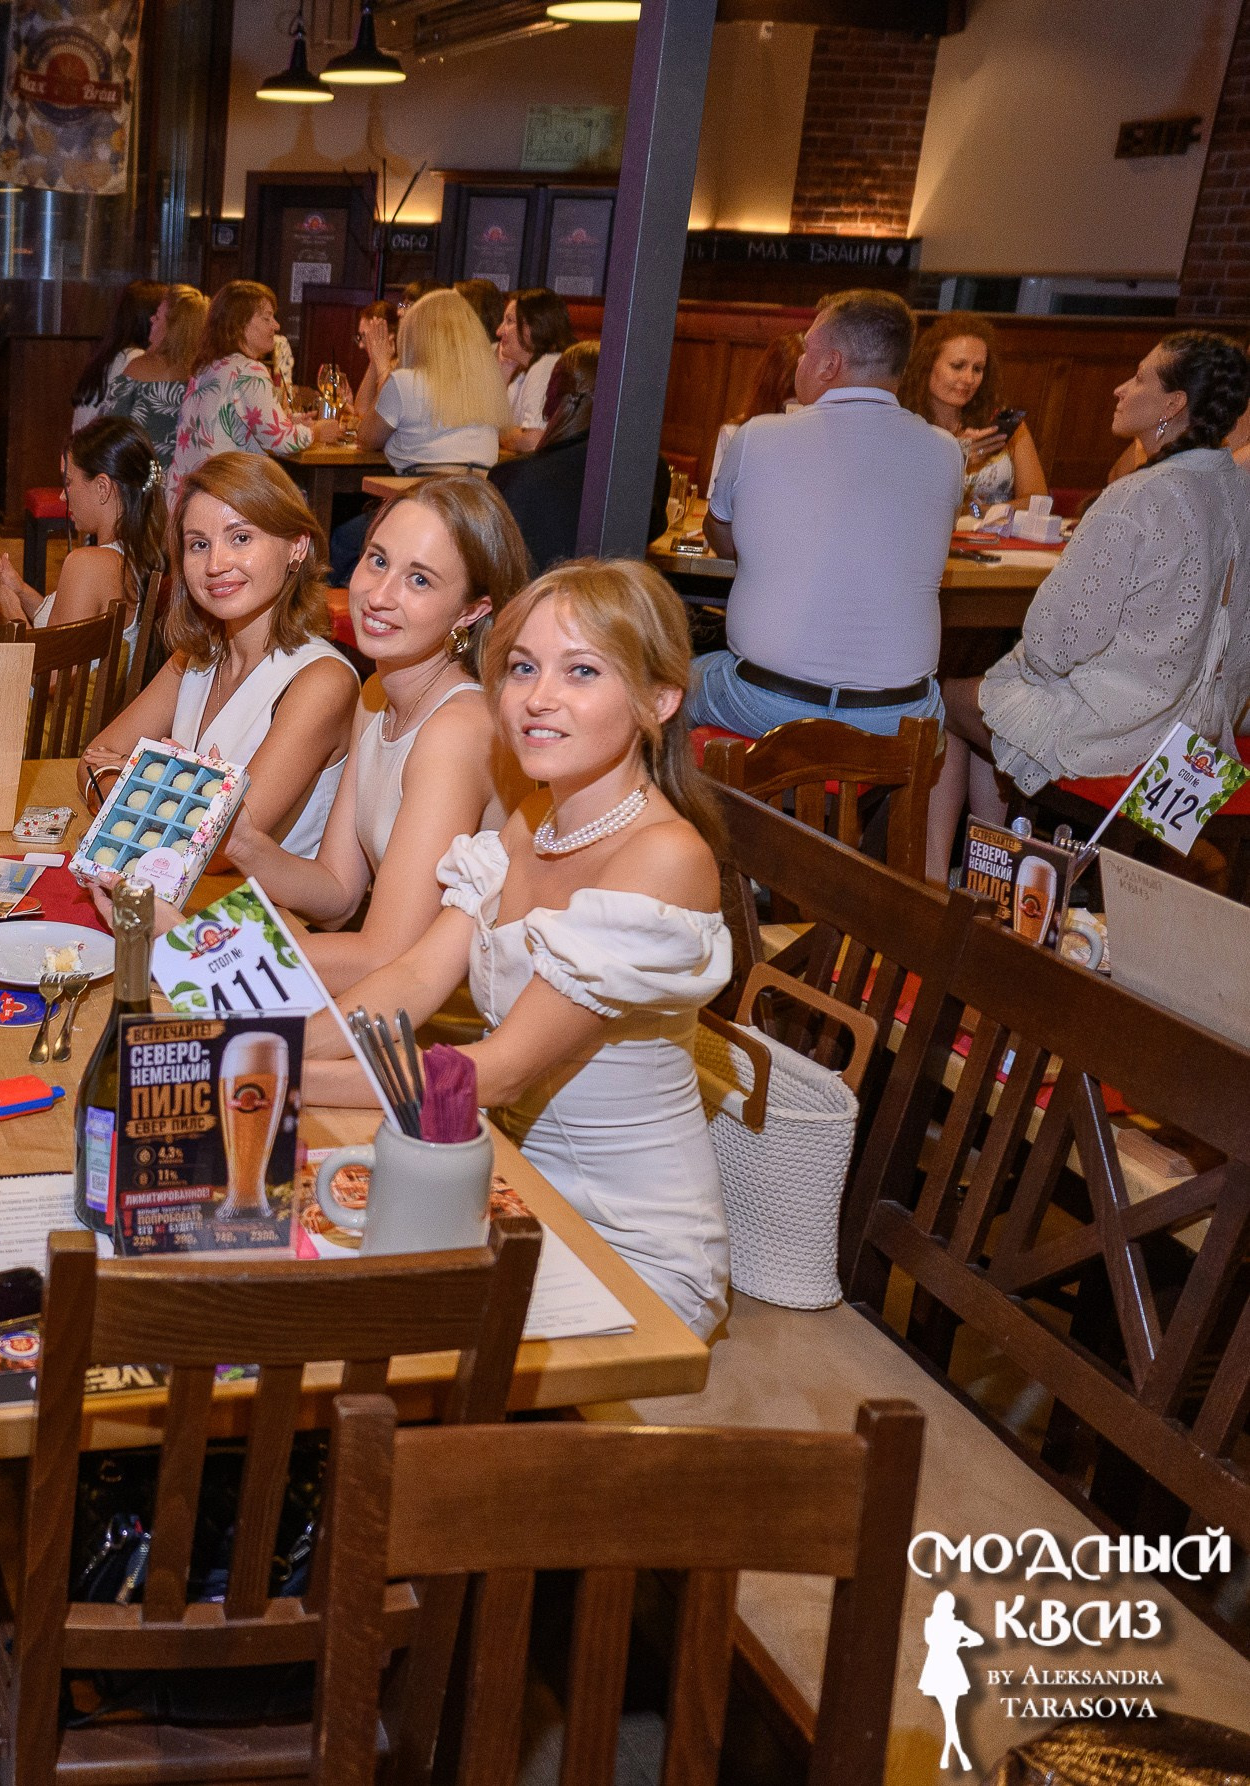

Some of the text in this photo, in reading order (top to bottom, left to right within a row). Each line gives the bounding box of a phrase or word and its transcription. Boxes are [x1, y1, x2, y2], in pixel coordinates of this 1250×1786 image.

[748, 240, 790, 261] MAX
[1178, 768, 1194, 785] СТОЛ
[1145, 777, 1199, 831] 412
[970, 840, 1013, 866] СЕВЕРО-
[969, 855, 1012, 882] НЕМЕЦКИЙ
[967, 869, 1010, 906] ПИЛС
[208, 953, 232, 974] СТОЛ
[211, 956, 291, 1013] 411
[133, 1022, 211, 1042] ВСТРЕЧАЙТЕ!
[130, 1041, 210, 1068] СЕВЕРО-
[130, 1059, 211, 1087] НЕМЕЦКИЙ
[131, 1081, 211, 1119] ПИЛС
[135, 1117, 206, 1135] ЕВЕР ПИЛС
